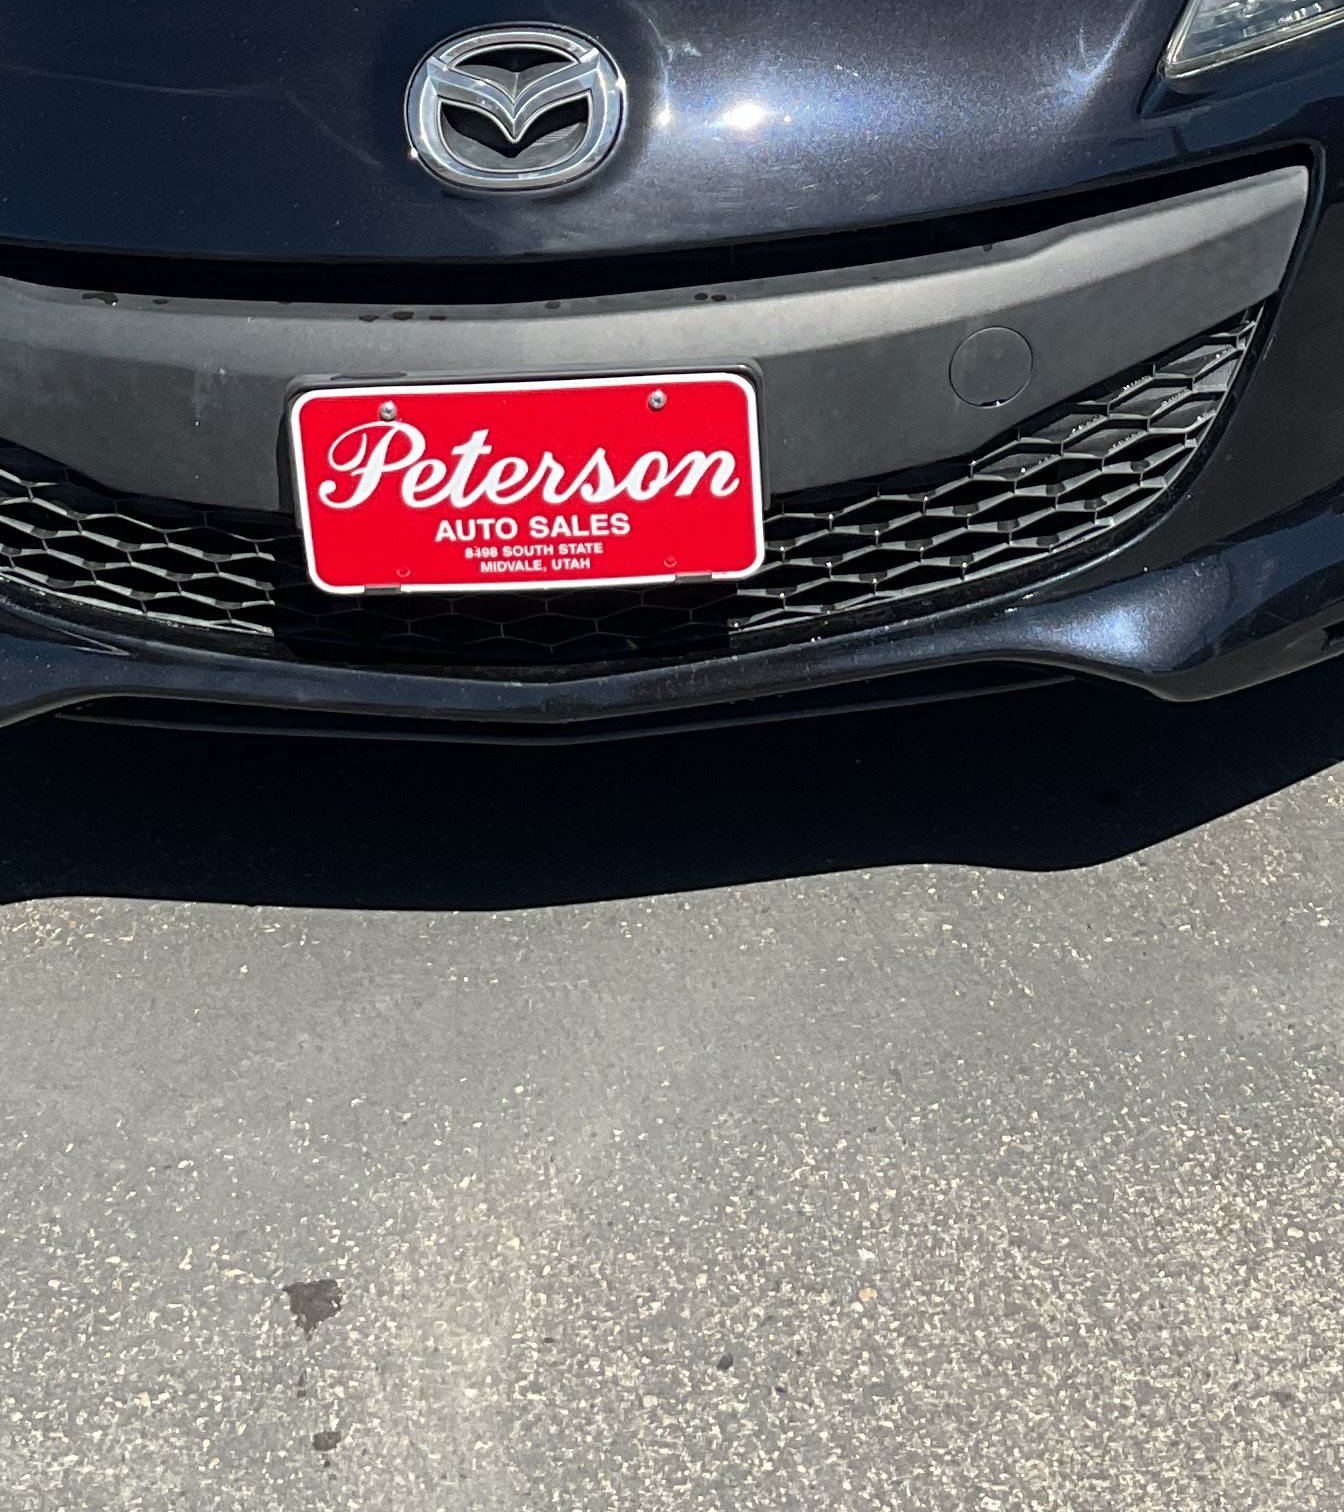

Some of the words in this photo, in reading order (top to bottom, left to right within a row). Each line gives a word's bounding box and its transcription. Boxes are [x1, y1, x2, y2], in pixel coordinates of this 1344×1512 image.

[318, 421, 740, 510] Peterson
[434, 517, 518, 542] AUTO
[529, 513, 631, 538] SALES
[502, 544, 554, 557] SOUTH
[558, 542, 604, 555] STATE
[480, 558, 547, 573] MIDVALE,
[551, 557, 591, 570] UTAH
